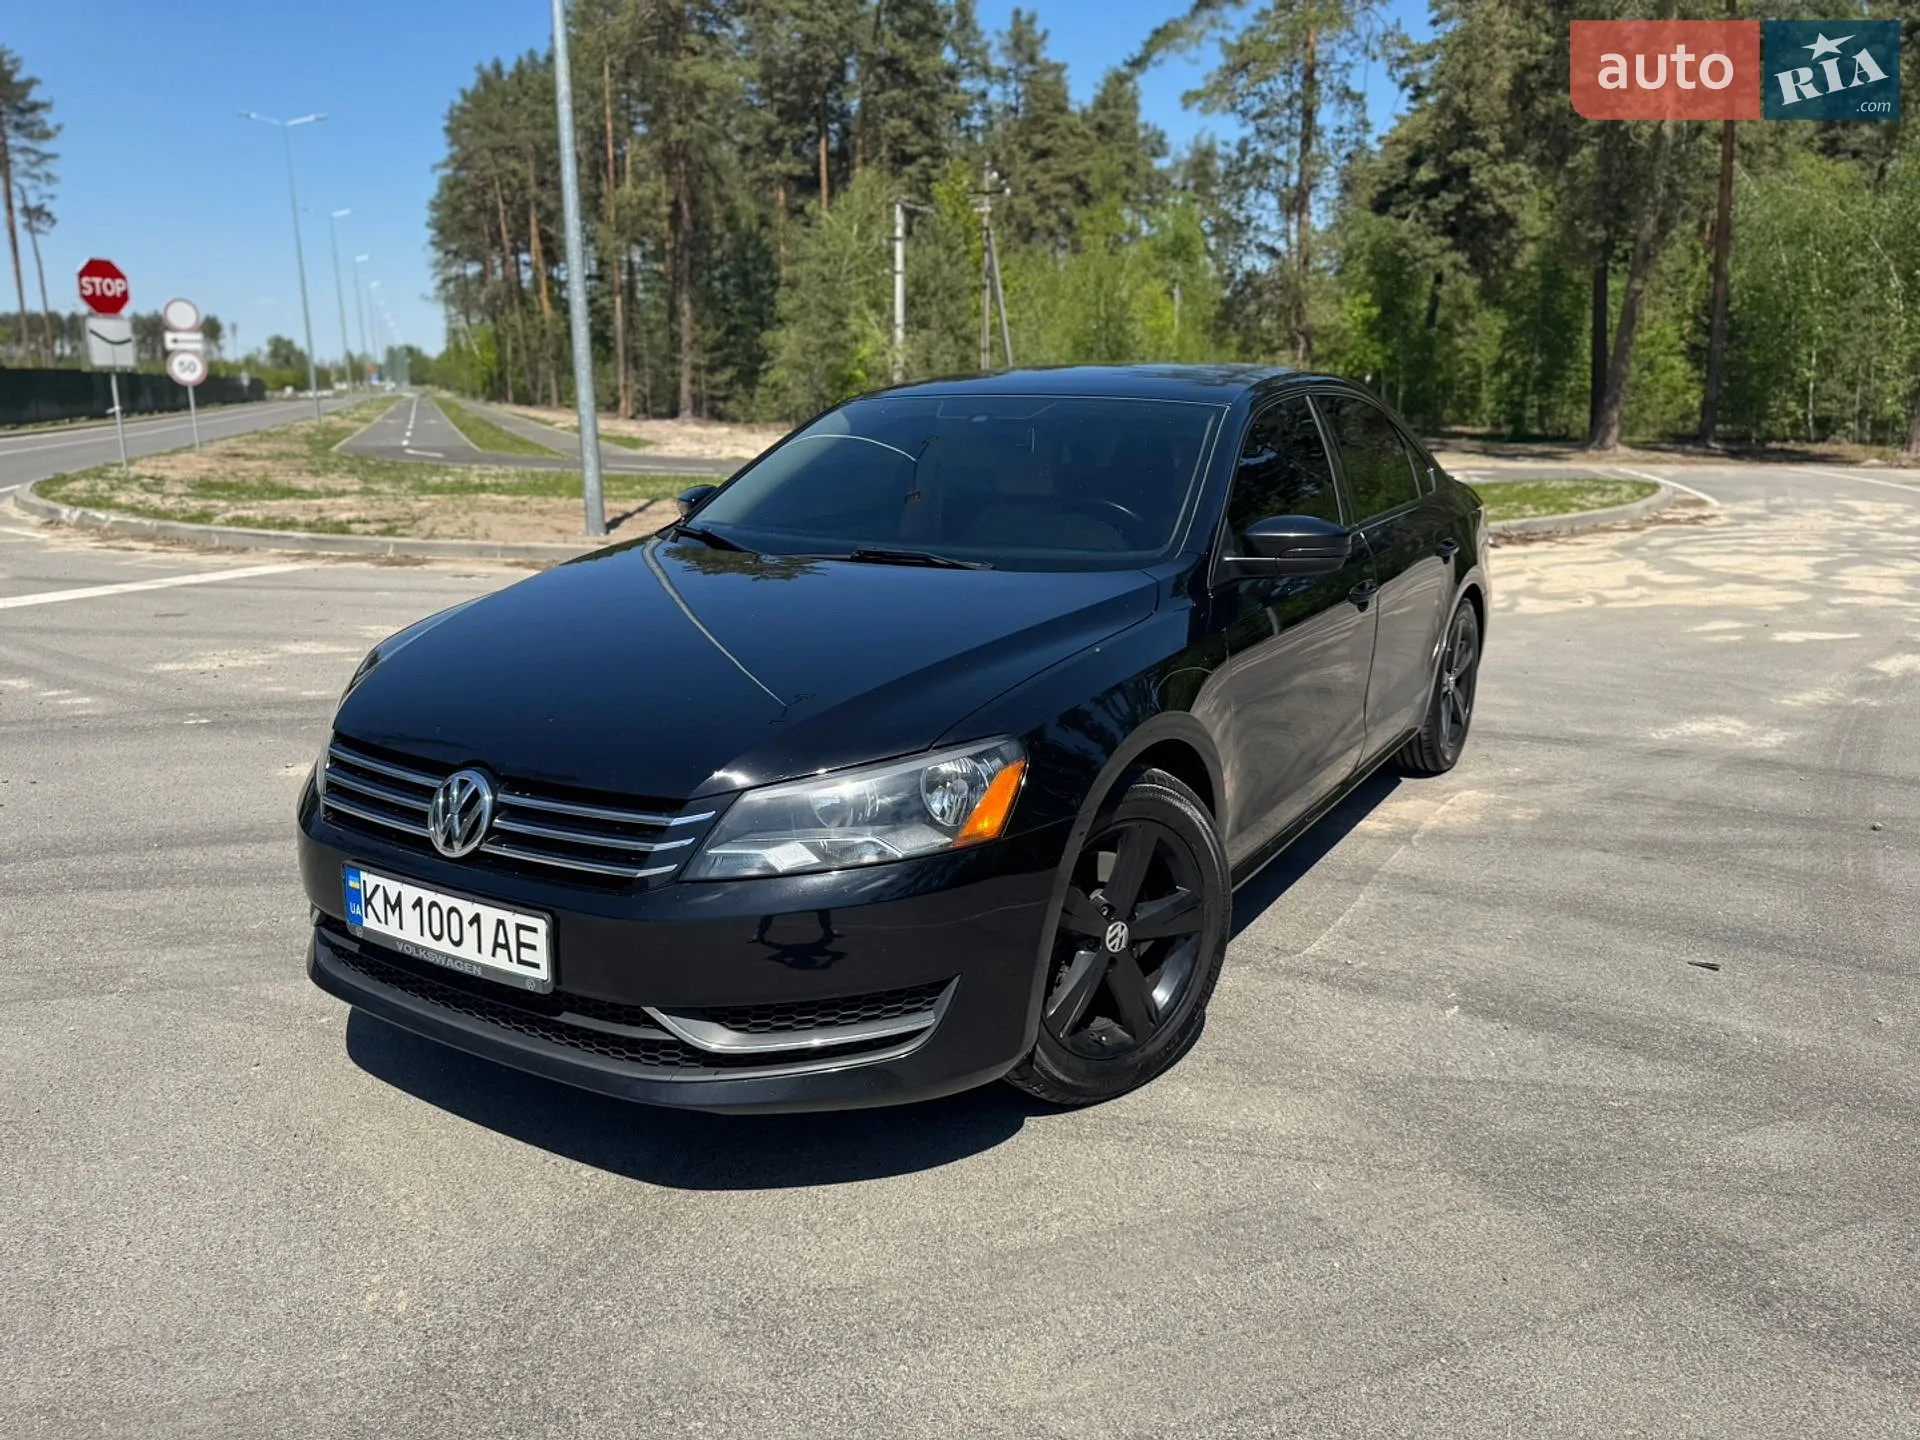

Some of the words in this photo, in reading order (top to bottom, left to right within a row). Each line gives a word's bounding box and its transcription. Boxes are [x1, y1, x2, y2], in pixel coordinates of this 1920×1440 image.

[80, 276, 127, 297] STOP
[349, 901, 362, 916] UA
[362, 879, 404, 930] KM
[411, 896, 483, 954] 1001
[491, 918, 541, 970] AE
[396, 941, 482, 977] VOLKSWAGEN
